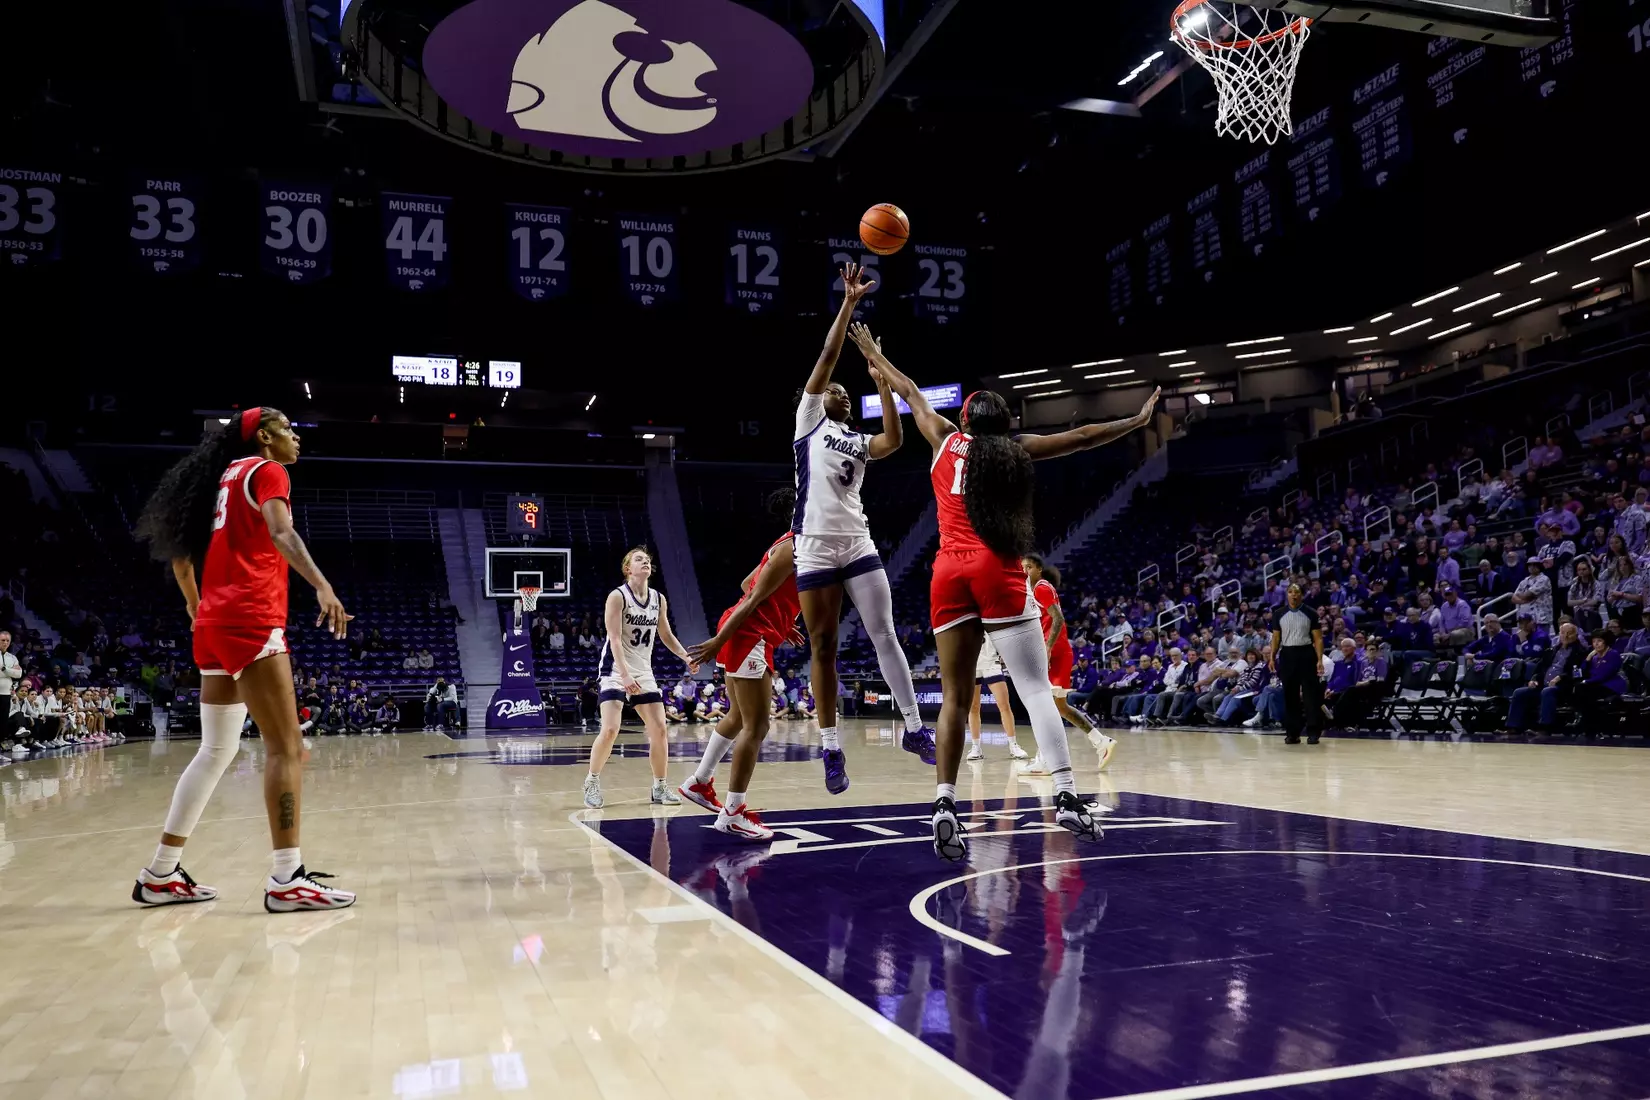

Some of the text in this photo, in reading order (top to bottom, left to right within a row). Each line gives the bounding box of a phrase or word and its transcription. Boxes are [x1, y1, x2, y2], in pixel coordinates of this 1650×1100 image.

[1550, 36, 1572, 53] 1973
[1520, 53, 1541, 71] 1959
[1552, 47, 1574, 66] 1975
[1426, 66, 1453, 88] SWEET
[1453, 44, 1487, 72] SIXTEEN
[1522, 64, 1541, 82] 1961
[1352, 62, 1401, 103] K-STATE
[1351, 112, 1376, 133] SWEET
[1376, 93, 1405, 118] SIXTEEN
[146, 179, 181, 192] PARR
[269, 190, 322, 204] BOOZER
[388, 200, 445, 214] MURRELL
[129, 194, 196, 243] 33
[514, 211, 561, 224] KRUGER
[620, 219, 674, 233] WILLIAMS
[264, 205, 328, 254] 30
[737, 229, 771, 242] EVANS
[385, 215, 447, 262] 44
[140, 247, 185, 259] 1955-58
[511, 226, 566, 272] 12
[621, 235, 674, 279] 10
[915, 244, 967, 258] RICHMOND
[275, 255, 317, 269] 1956-59
[729, 243, 780, 286] 12
[396, 266, 437, 277] 1962-64
[832, 251, 881, 294] 25
[918, 258, 966, 300] 23
[519, 275, 558, 286] 1971-74
[629, 282, 666, 293] 1972-76
[737, 290, 773, 300] 1974-78
[432, 367, 450, 380] 18
[465, 361, 480, 370] 4:26
[496, 370, 514, 382] 19
[736, 419, 761, 436] 15
[823, 434, 866, 465] Wildca
[838, 459, 855, 487] 3
[950, 457, 967, 495] 1
[518, 502, 539, 513] 4:26
[524, 512, 536, 529] 9
[630, 628, 651, 647] 34
[494, 699, 543, 718] Dillons
